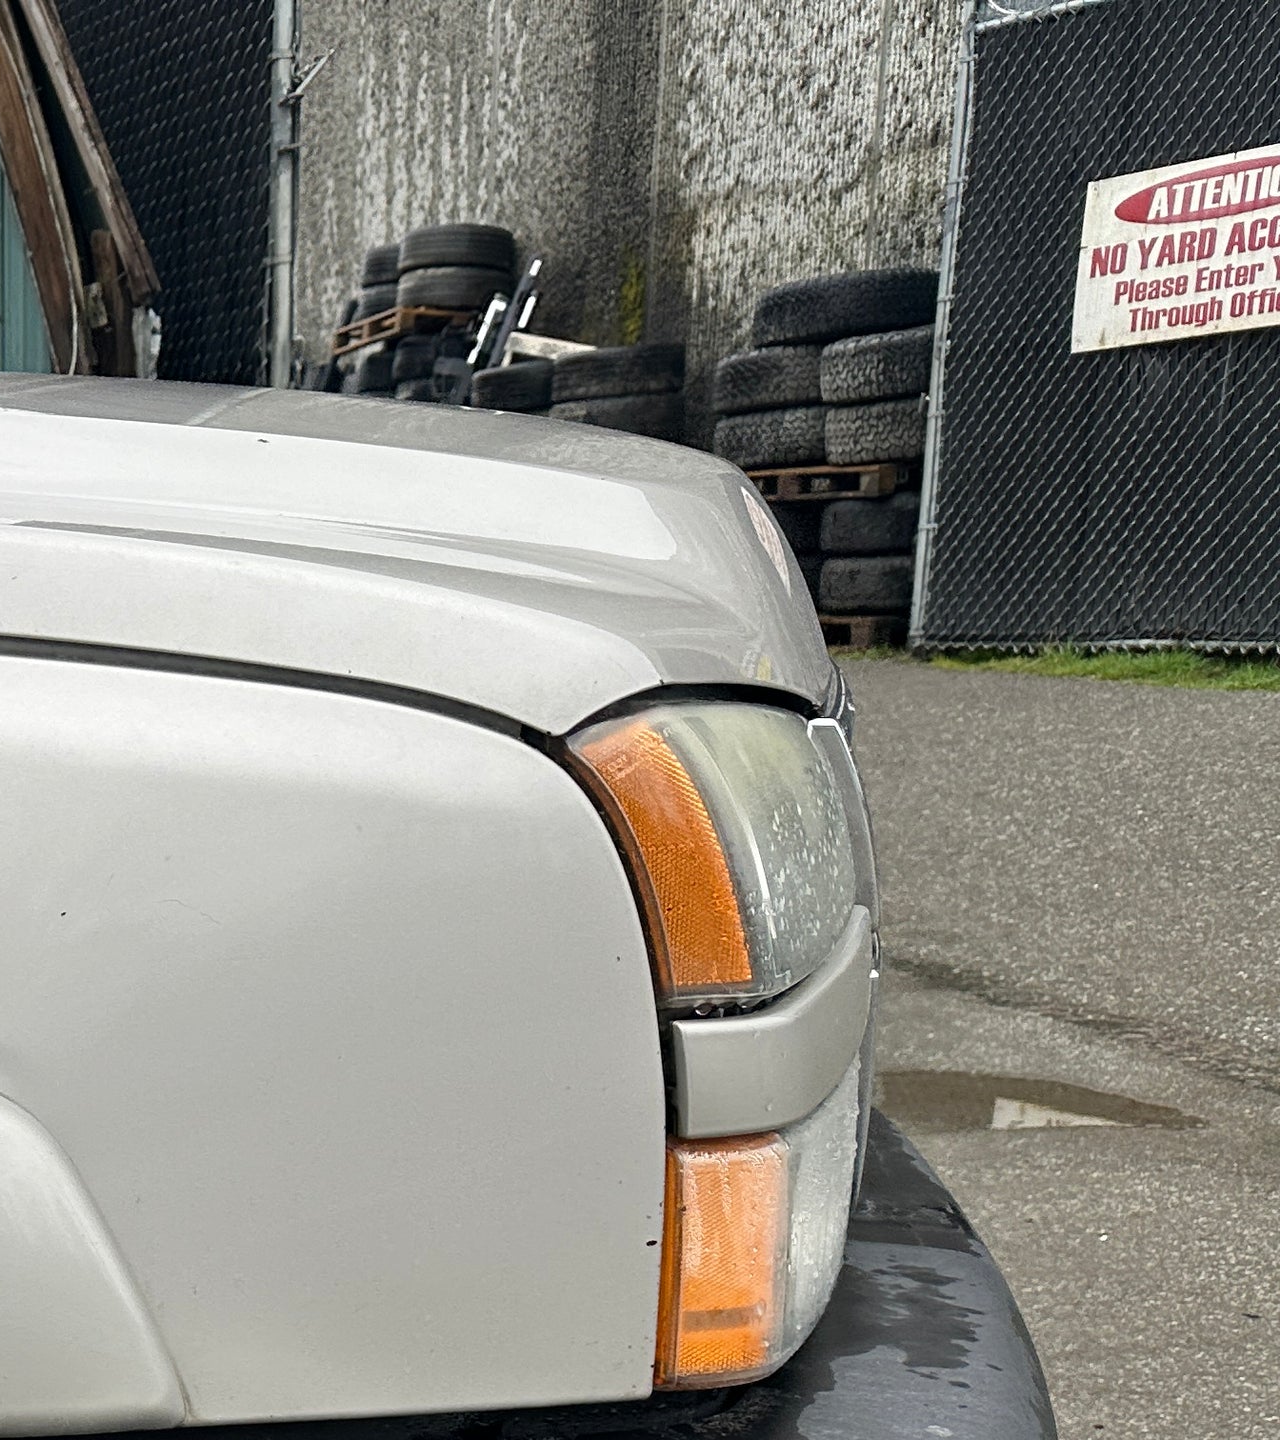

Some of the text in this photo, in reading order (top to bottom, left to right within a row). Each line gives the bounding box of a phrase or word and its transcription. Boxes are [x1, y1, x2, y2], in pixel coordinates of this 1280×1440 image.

[1090, 243, 1129, 279] NO
[1138, 227, 1217, 270] YARD
[1113, 273, 1189, 306] Please
[1194, 262, 1264, 293] Enter
[1129, 295, 1224, 332] Through
